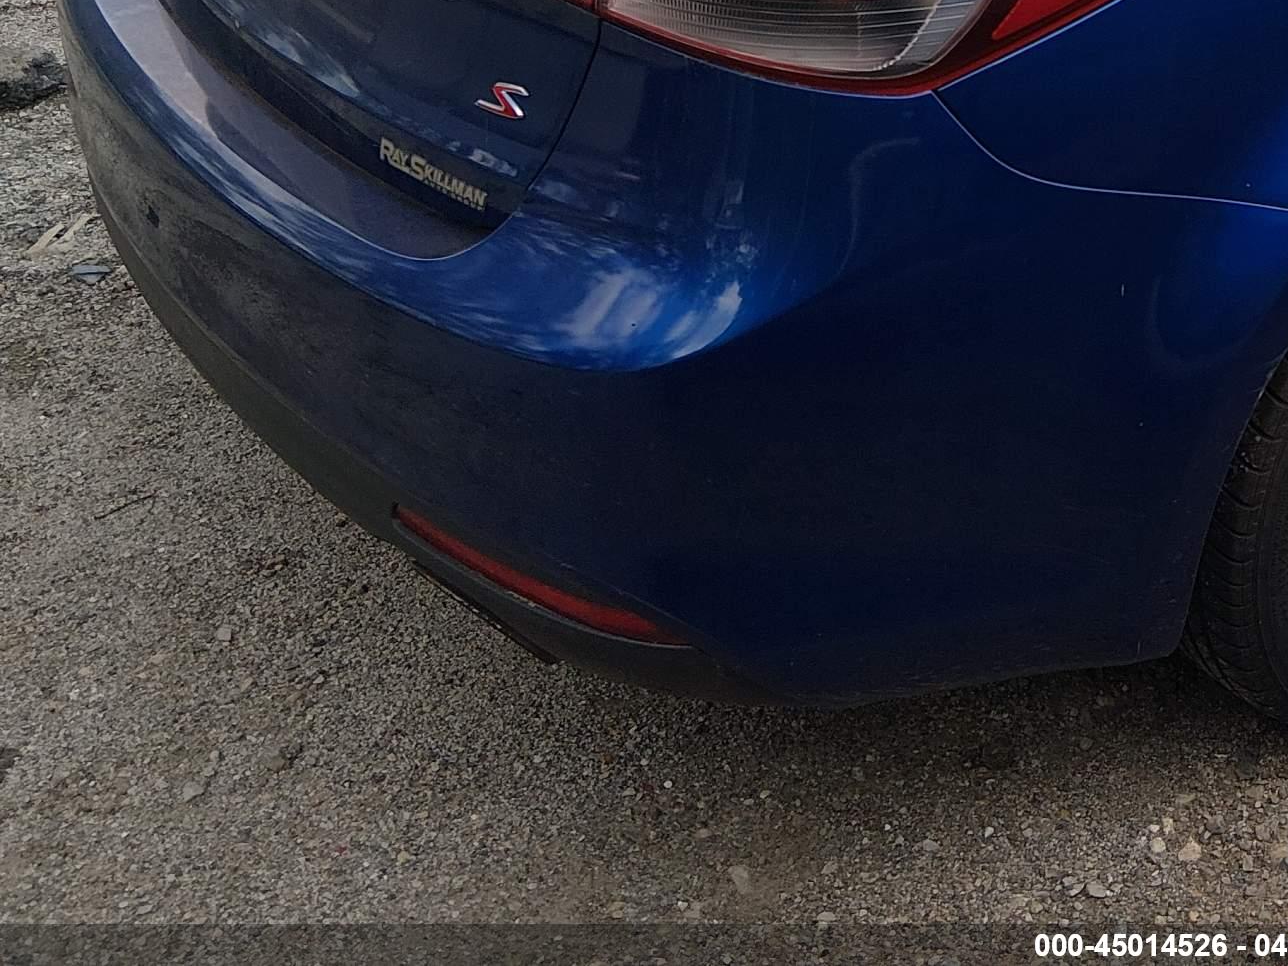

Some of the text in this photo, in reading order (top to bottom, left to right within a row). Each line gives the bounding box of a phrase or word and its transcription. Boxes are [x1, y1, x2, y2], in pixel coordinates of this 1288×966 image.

[474, 82, 529, 119] S
[379, 137, 411, 174] RAY
[410, 153, 488, 206] SKILLMAN
